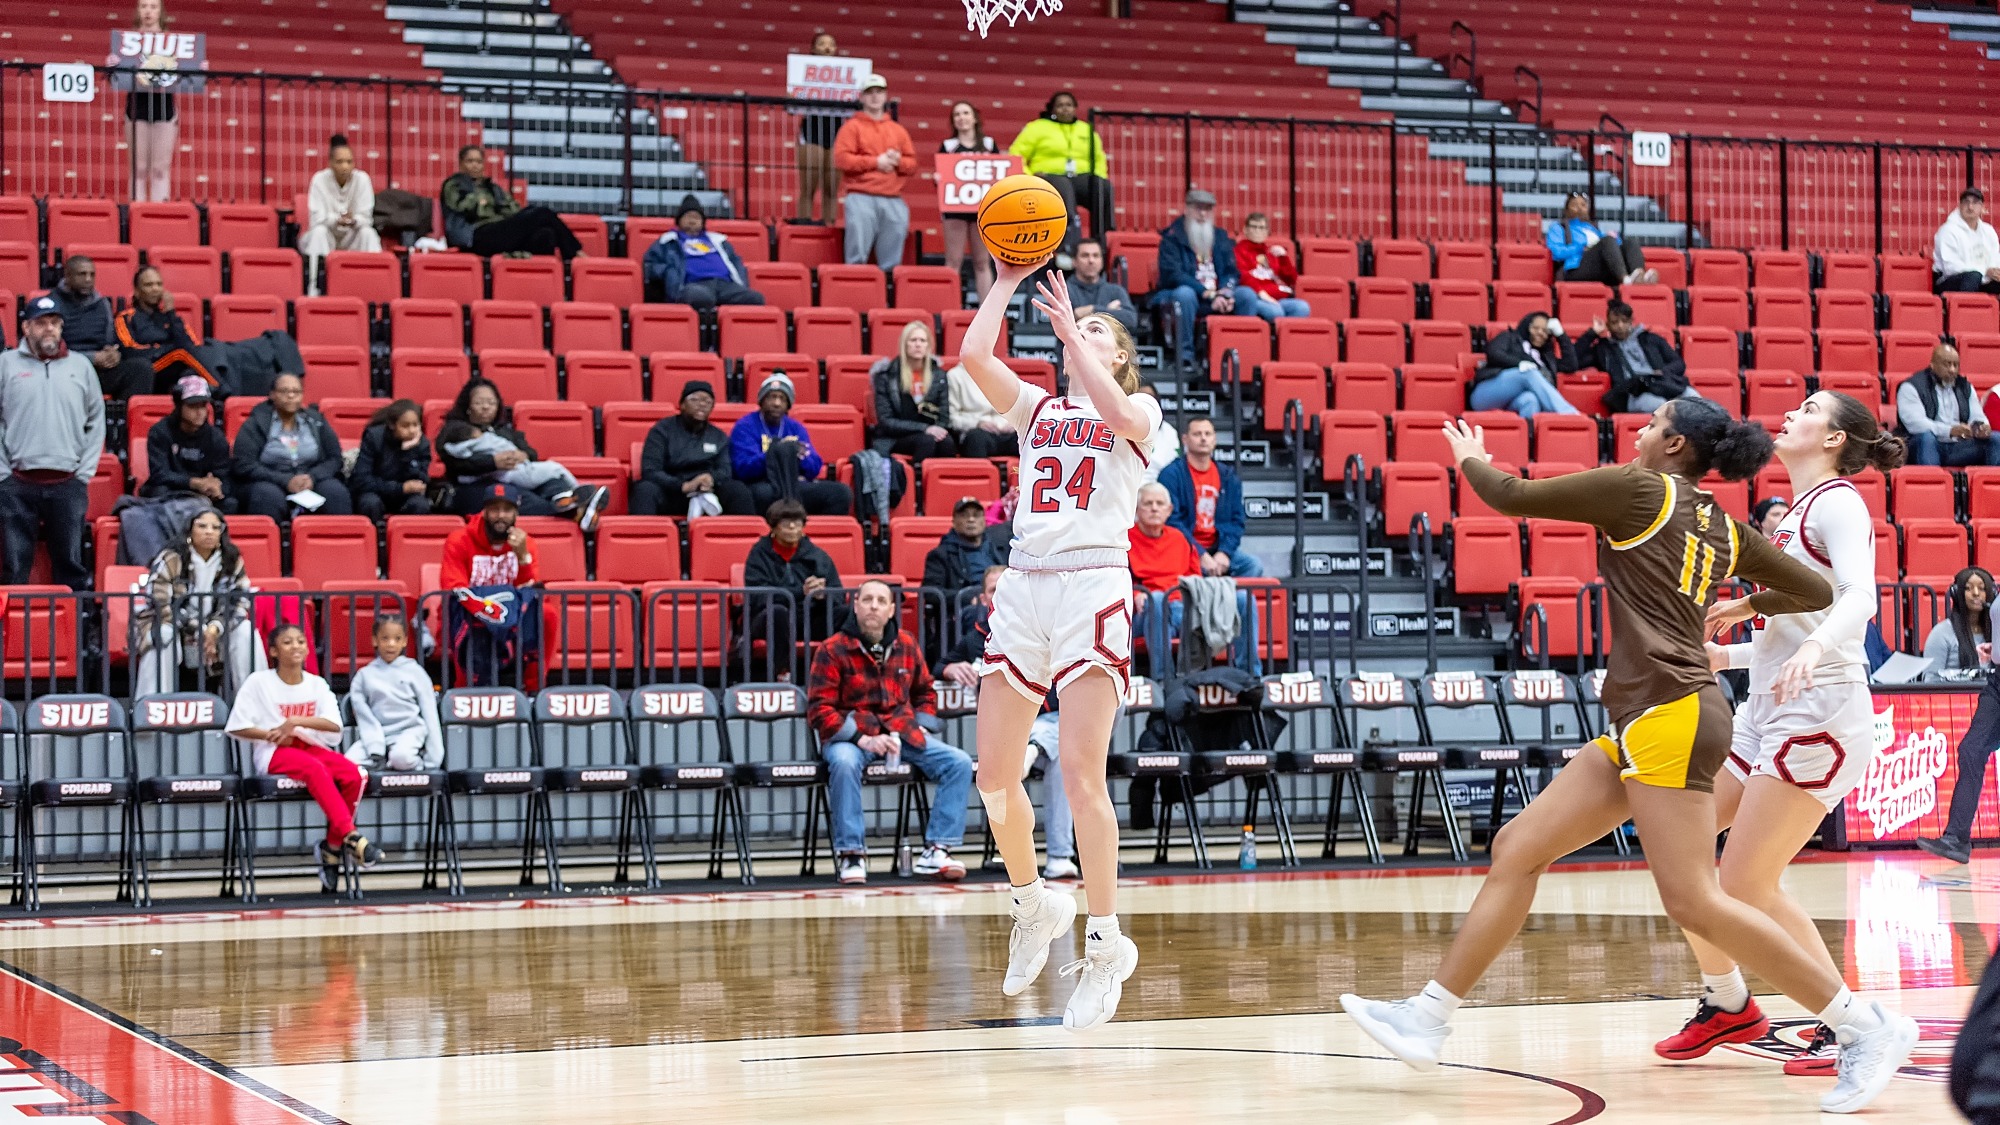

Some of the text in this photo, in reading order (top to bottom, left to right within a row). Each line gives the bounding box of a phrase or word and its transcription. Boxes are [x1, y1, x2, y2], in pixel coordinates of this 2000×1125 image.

[120, 31, 196, 58] SIUE
[48, 73, 88, 93] 109
[805, 64, 856, 84] ROLL
[1637, 141, 1665, 158] 110
[954, 159, 1011, 181] GET
[1031, 418, 1115, 452] SIUE
[1031, 456, 1096, 513] 24
[1677, 530, 1716, 607] 11
[936, 687, 977, 709] IUE
[1198, 684, 1238, 705] IU
[1268, 680, 1322, 703] SIUE
[1352, 680, 1403, 702] SIUE
[1432, 679, 1485, 700] SIUE
[1513, 678, 1564, 699] SIUE
[454, 696, 516, 718] SIUE
[549, 694, 610, 716] SIUE
[644, 692, 703, 714] SIUE
[736, 690, 795, 712] SIUE
[41, 702, 109, 727] SIUE
[147, 700, 213, 725] SIUE
[1138, 757, 1180, 767] COUGARS
[1226, 755, 1267, 766] COUGARS
[1313, 753, 1354, 764] COUGARS
[1398, 752, 1438, 762] COUGARS
[1480, 749, 1519, 760] COUGARS
[484, 772, 531, 784] COUGARS
[581, 770, 627, 781] COUGARS
[678, 768, 723, 779] COUGARS
[772, 766, 816, 777] COUGARS
[1859, 728, 1946, 809] Prairie
[61, 783, 112, 795] COUGARS
[172, 780, 222, 793] COUGARS
[381, 775, 429, 787] COUGARS
[1870, 781, 1935, 839] Farms
